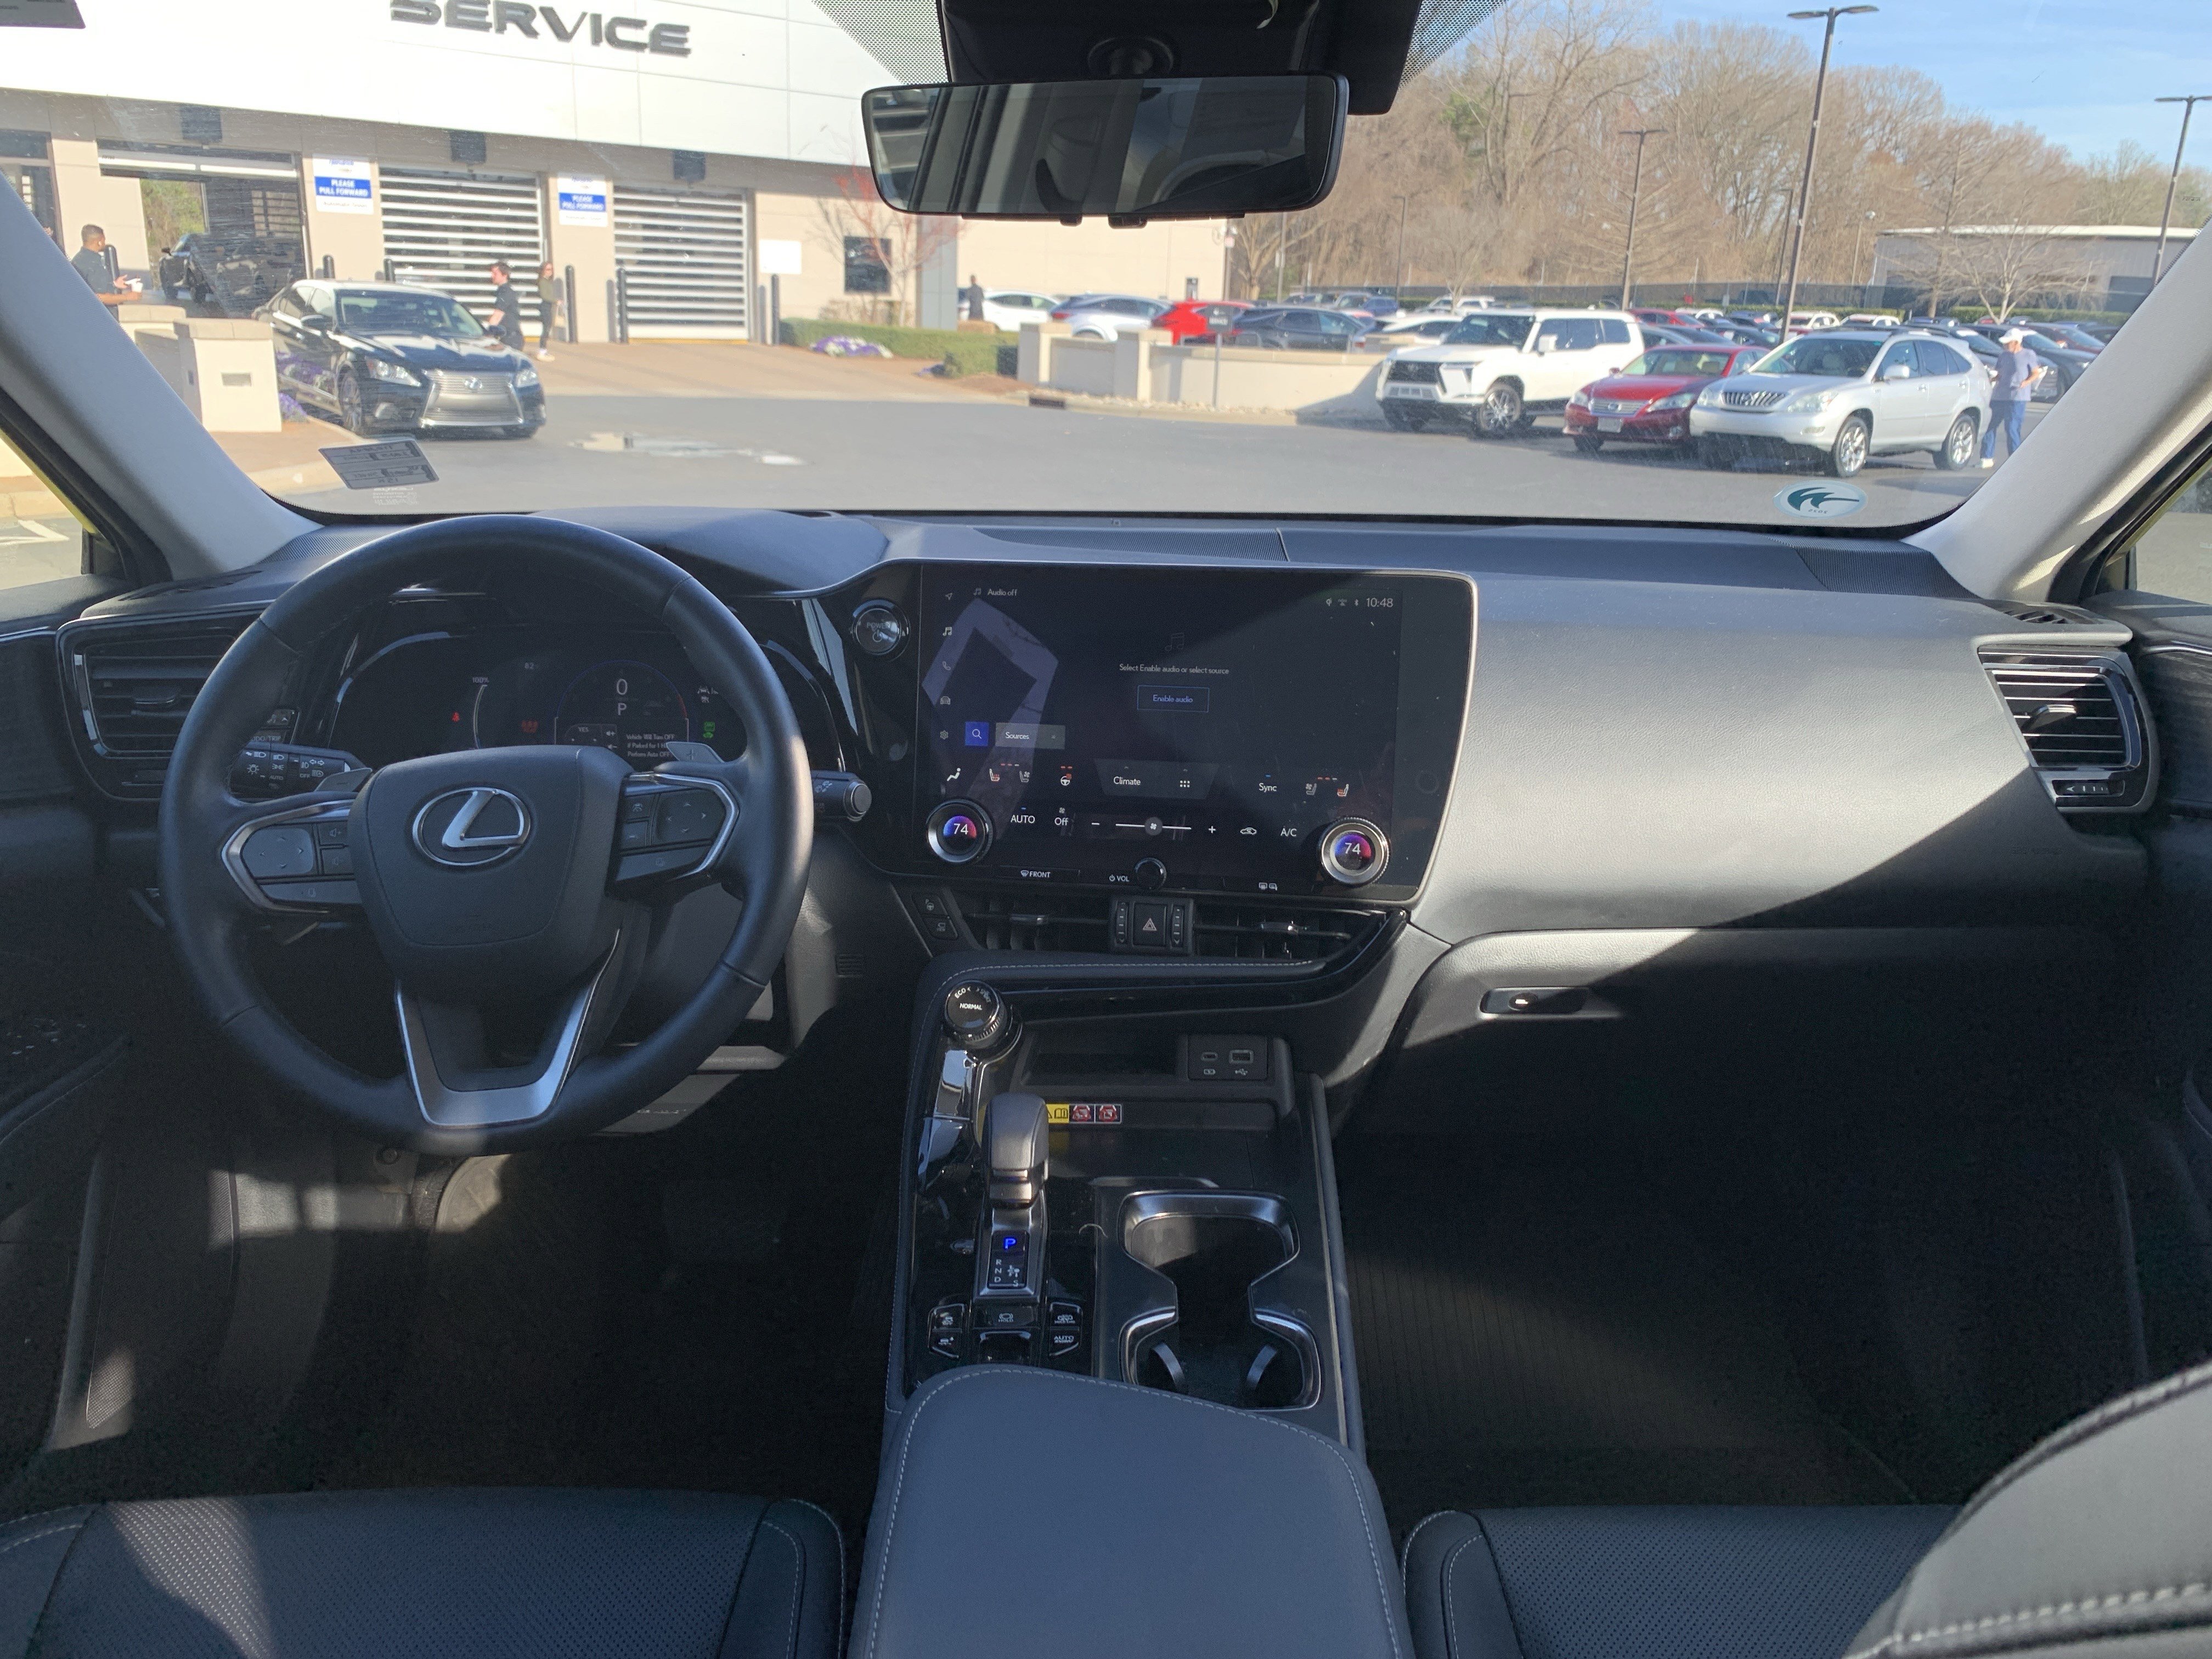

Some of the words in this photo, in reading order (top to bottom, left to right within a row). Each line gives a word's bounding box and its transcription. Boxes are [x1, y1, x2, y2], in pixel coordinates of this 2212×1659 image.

[390, 0, 692, 57] SERVICE
[331, 179, 355, 188] PLEASE
[336, 188, 369, 197] FORWARD
[988, 588, 1006, 597] Audio
[1007, 588, 1018, 596] off
[1366, 597, 1393, 608] 10:48
[1119, 663, 1138, 672] Select
[1139, 664, 1161, 673] Enable
[1163, 664, 1180, 673] audio
[1189, 664, 1207, 673] select
[616, 678, 628, 695] 0
[1153, 694, 1173, 703] Enable
[1174, 695, 1193, 704] audio
[618, 702, 627, 715] P
[1005, 731, 1030, 740] Sources
[1113, 776, 1141, 786] Climate
[1259, 783, 1277, 793] Sync
[1011, 815, 1036, 824] AUTO
[1054, 817, 1069, 826] Off
[953, 823, 969, 835] 74
[1280, 828, 1297, 837] A/C
[1345, 842, 1361, 855] 74
[954, 987, 967, 999] ECO
[1005, 1238, 1017, 1249] P
